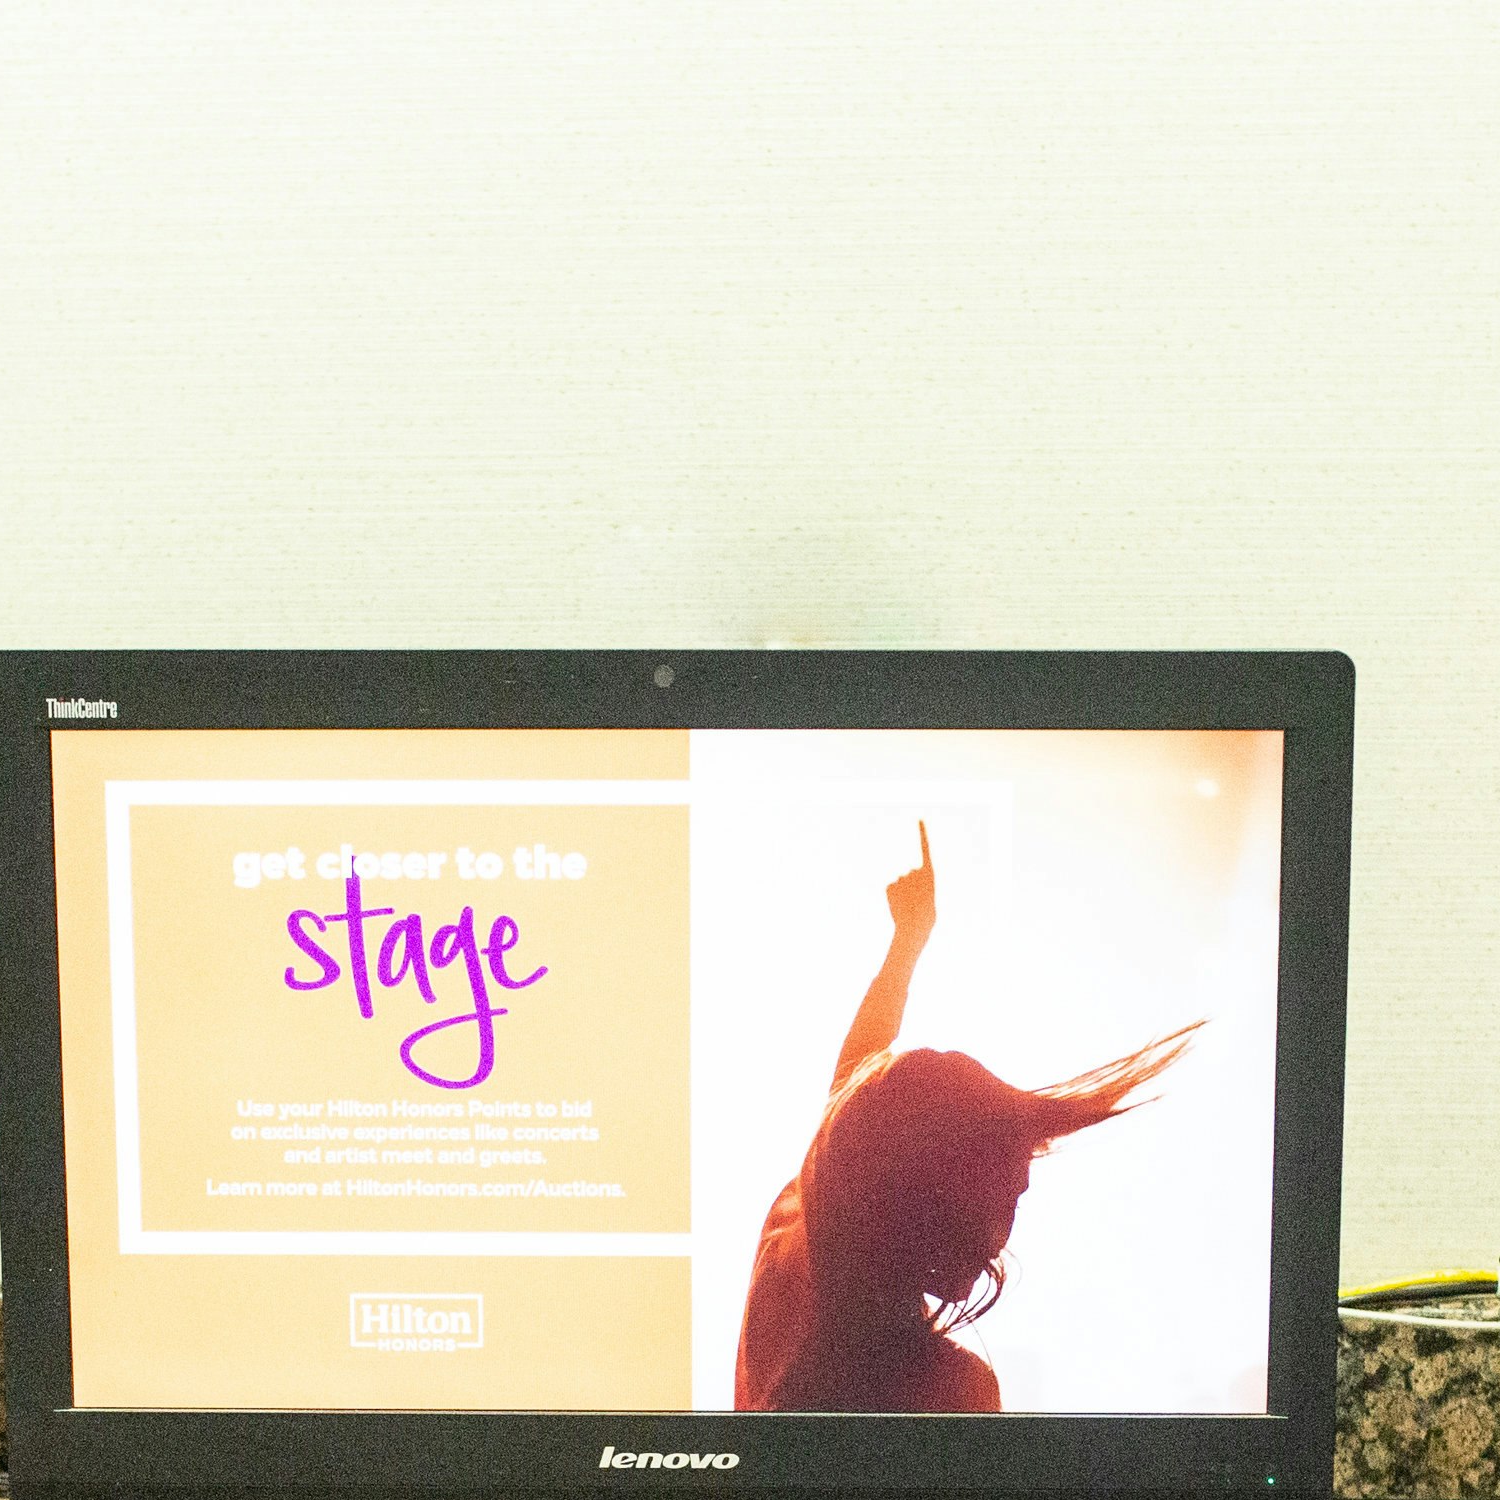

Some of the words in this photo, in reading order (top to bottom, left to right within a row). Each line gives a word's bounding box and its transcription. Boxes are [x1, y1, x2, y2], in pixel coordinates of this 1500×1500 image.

[45, 697, 118, 719] ThinkCentre
[233, 846, 307, 889] get
[316, 843, 448, 881] closer
[456, 846, 504, 881] to
[513, 843, 589, 881] the
[284, 856, 549, 1090] stage
[237, 1100, 275, 1117] Use
[278, 1103, 323, 1122] your
[327, 1099, 388, 1118] Hilton
[392, 1100, 465, 1118] Honors
[468, 1100, 532, 1118] Points
[535, 1101, 558, 1118] to
[561, 1100, 593, 1118] bid
[230, 1126, 257, 1140] on
[260, 1124, 349, 1140] exclusive
[353, 1125, 471, 1144] experiences
[474, 1124, 509, 1141] like
[513, 1125, 600, 1141] concerts
[284, 1147, 321, 1164] and
[325, 1147, 378, 1164] artist
[381, 1149, 433, 1164] meet
[437, 1148, 475, 1165] and
[479, 1149, 548, 1168] greets.
[206, 1179, 262, 1196] Learn
[266, 1182, 318, 1196] more
[322, 1180, 342, 1196] at
[361, 1303, 472, 1334] Hilton
[377, 1338, 457, 1352] HONORS
[598, 1446, 741, 1470] lenovo
